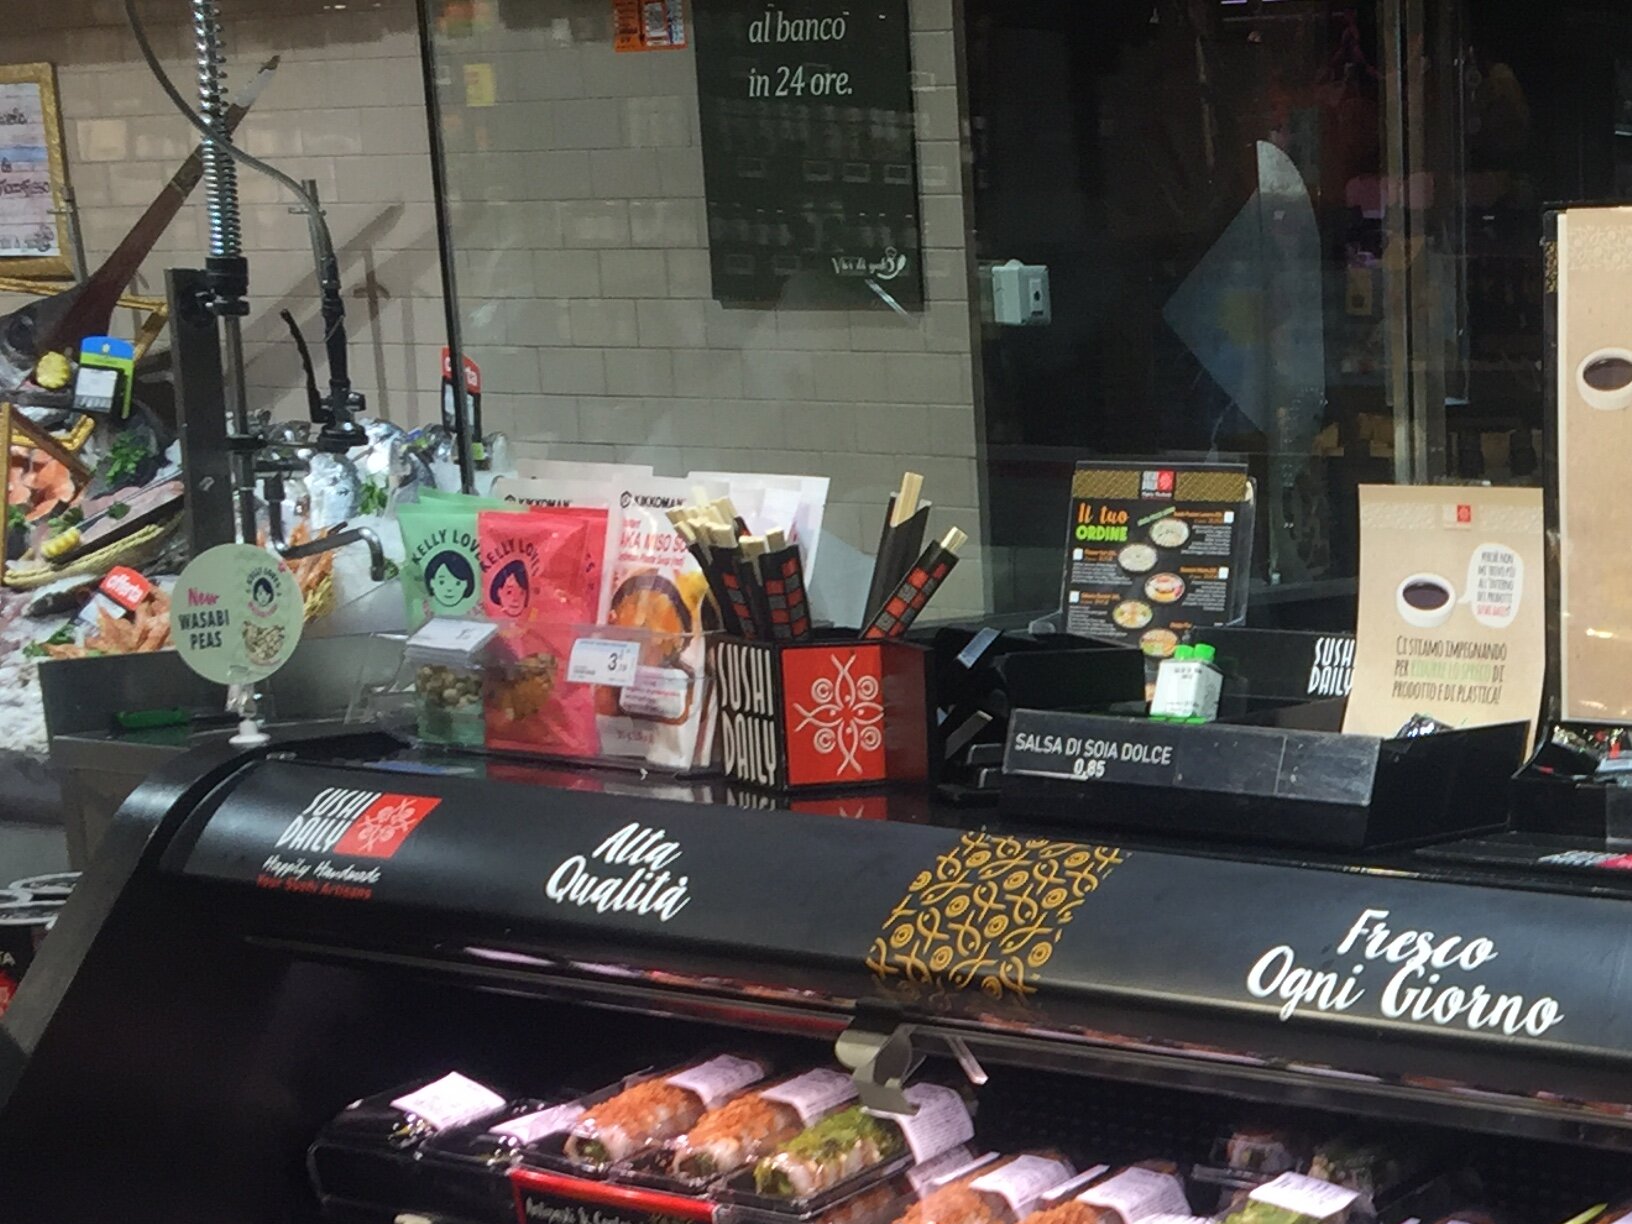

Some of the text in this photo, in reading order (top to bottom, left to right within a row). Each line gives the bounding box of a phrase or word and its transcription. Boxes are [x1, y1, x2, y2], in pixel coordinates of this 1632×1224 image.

[749, 10, 846, 43] al banco
[749, 66, 853, 97] in 24 ore.
[633, 495, 685, 509] KIKKOMAN
[1100, 506, 1129, 525] tuo
[411, 529, 481, 565] KELLY LOVE
[1075, 524, 1128, 542] ORDINE
[479, 538, 514, 573] KELLY
[105, 574, 145, 602] offerta
[187, 588, 220, 606] New
[178, 609, 230, 630] WASABI
[190, 631, 222, 650] PEAS
[1313, 636, 1356, 667] SUSH
[1409, 638, 1444, 657] STIAMO
[1445, 640, 1507, 661] IMPEGNANDO
[608, 652, 618, 671] 3
[1394, 659, 1409, 677] PER
[1492, 665, 1505, 683] DI
[717, 642, 774, 717] SUSHI
[1392, 680, 1436, 700] PRODOTTO
[1456, 685, 1502, 704] PLASTICA!
[722, 710, 776, 787] DAILY
[1015, 732, 1173, 765] SALSA DI SOIA DOLCE
[1073, 757, 1106, 779] 0,85
[302, 786, 383, 821] SUSHI
[275, 814, 352, 853] DAILY
[591, 821, 683, 871] Alta
[262, 854, 382, 884] Happily Handmade
[545, 854, 691, 922] Qualità
[1336, 908, 1499, 971] Fresco
[1247, 945, 1565, 1037] Ogni Giorno
